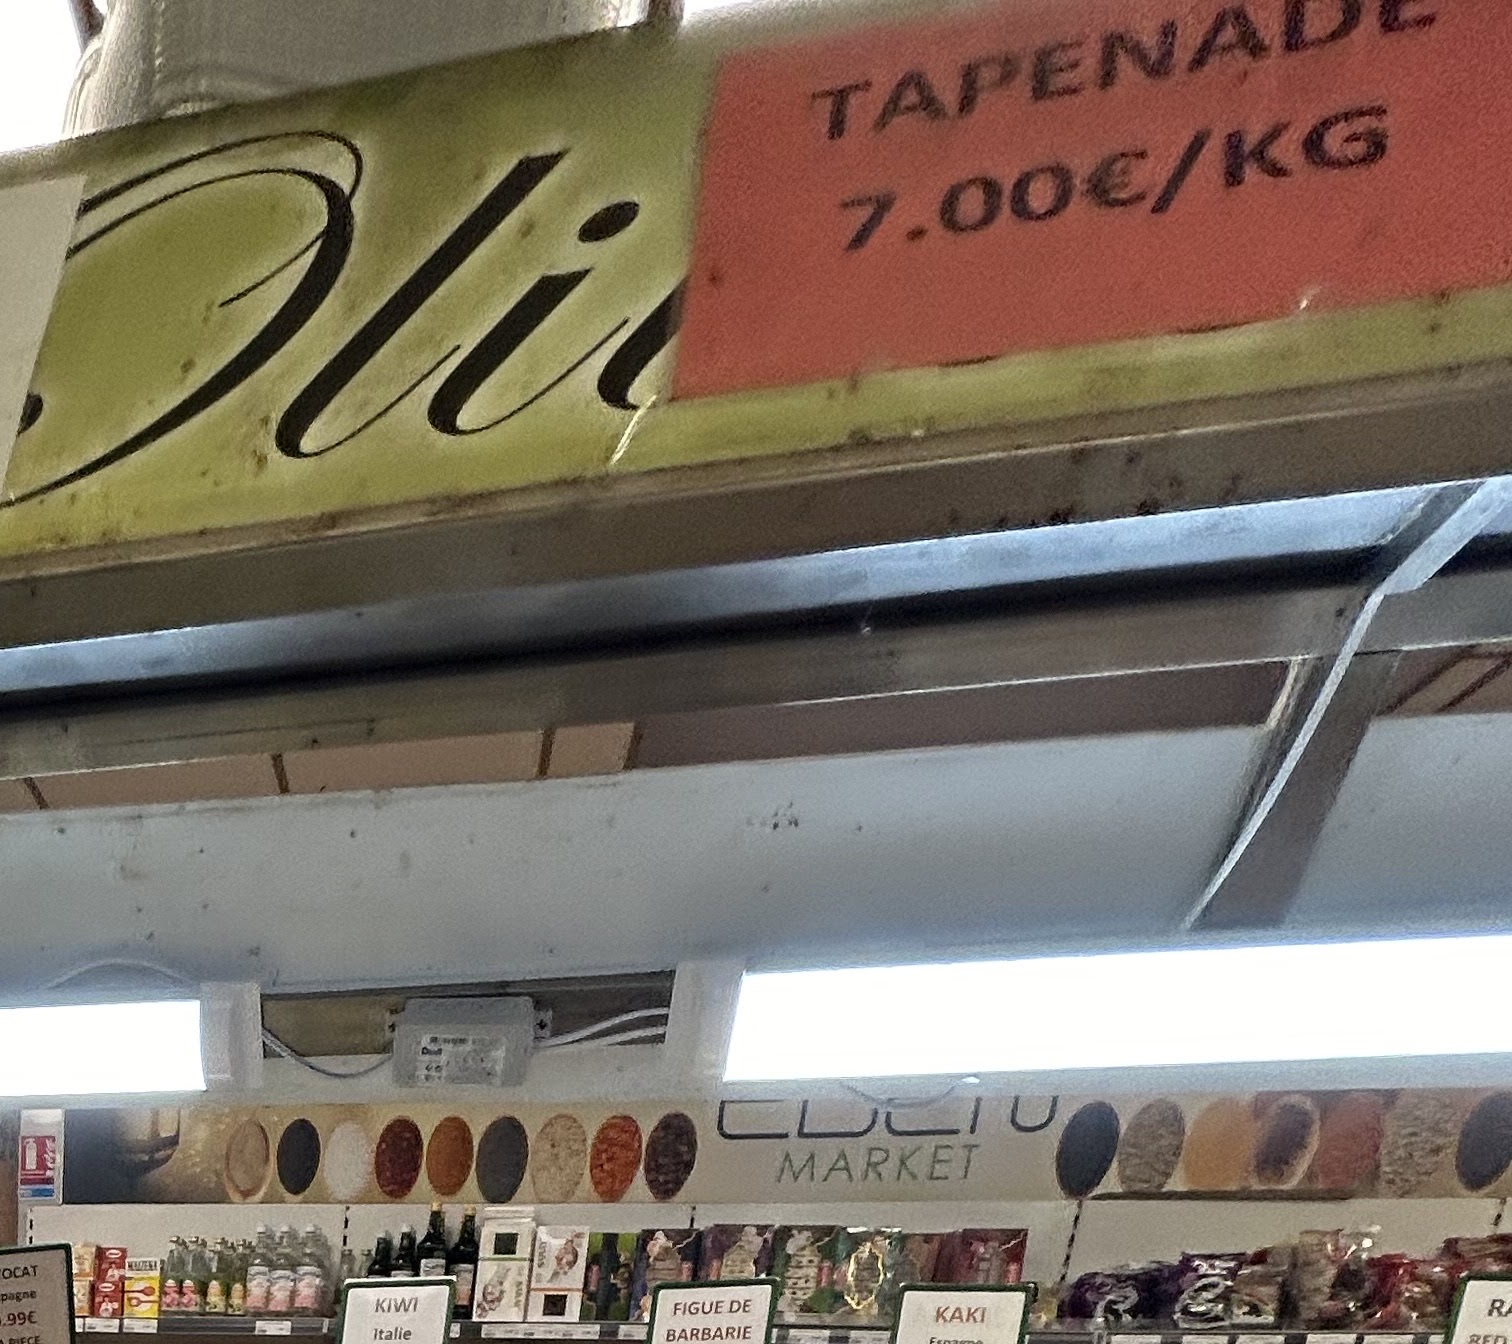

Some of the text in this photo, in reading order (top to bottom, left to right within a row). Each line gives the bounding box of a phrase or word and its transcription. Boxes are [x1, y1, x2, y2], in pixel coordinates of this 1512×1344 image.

[840, 105, 1388, 252] 7.00€/KG
[776, 1144, 980, 1184] MARKET
[374, 1296, 419, 1313] KIWI
[672, 1299, 752, 1317] FIGUE DE
[935, 1306, 987, 1324] KAKI
[373, 1326, 412, 1341] Italie
[665, 1325, 752, 1342] BARBARIE
